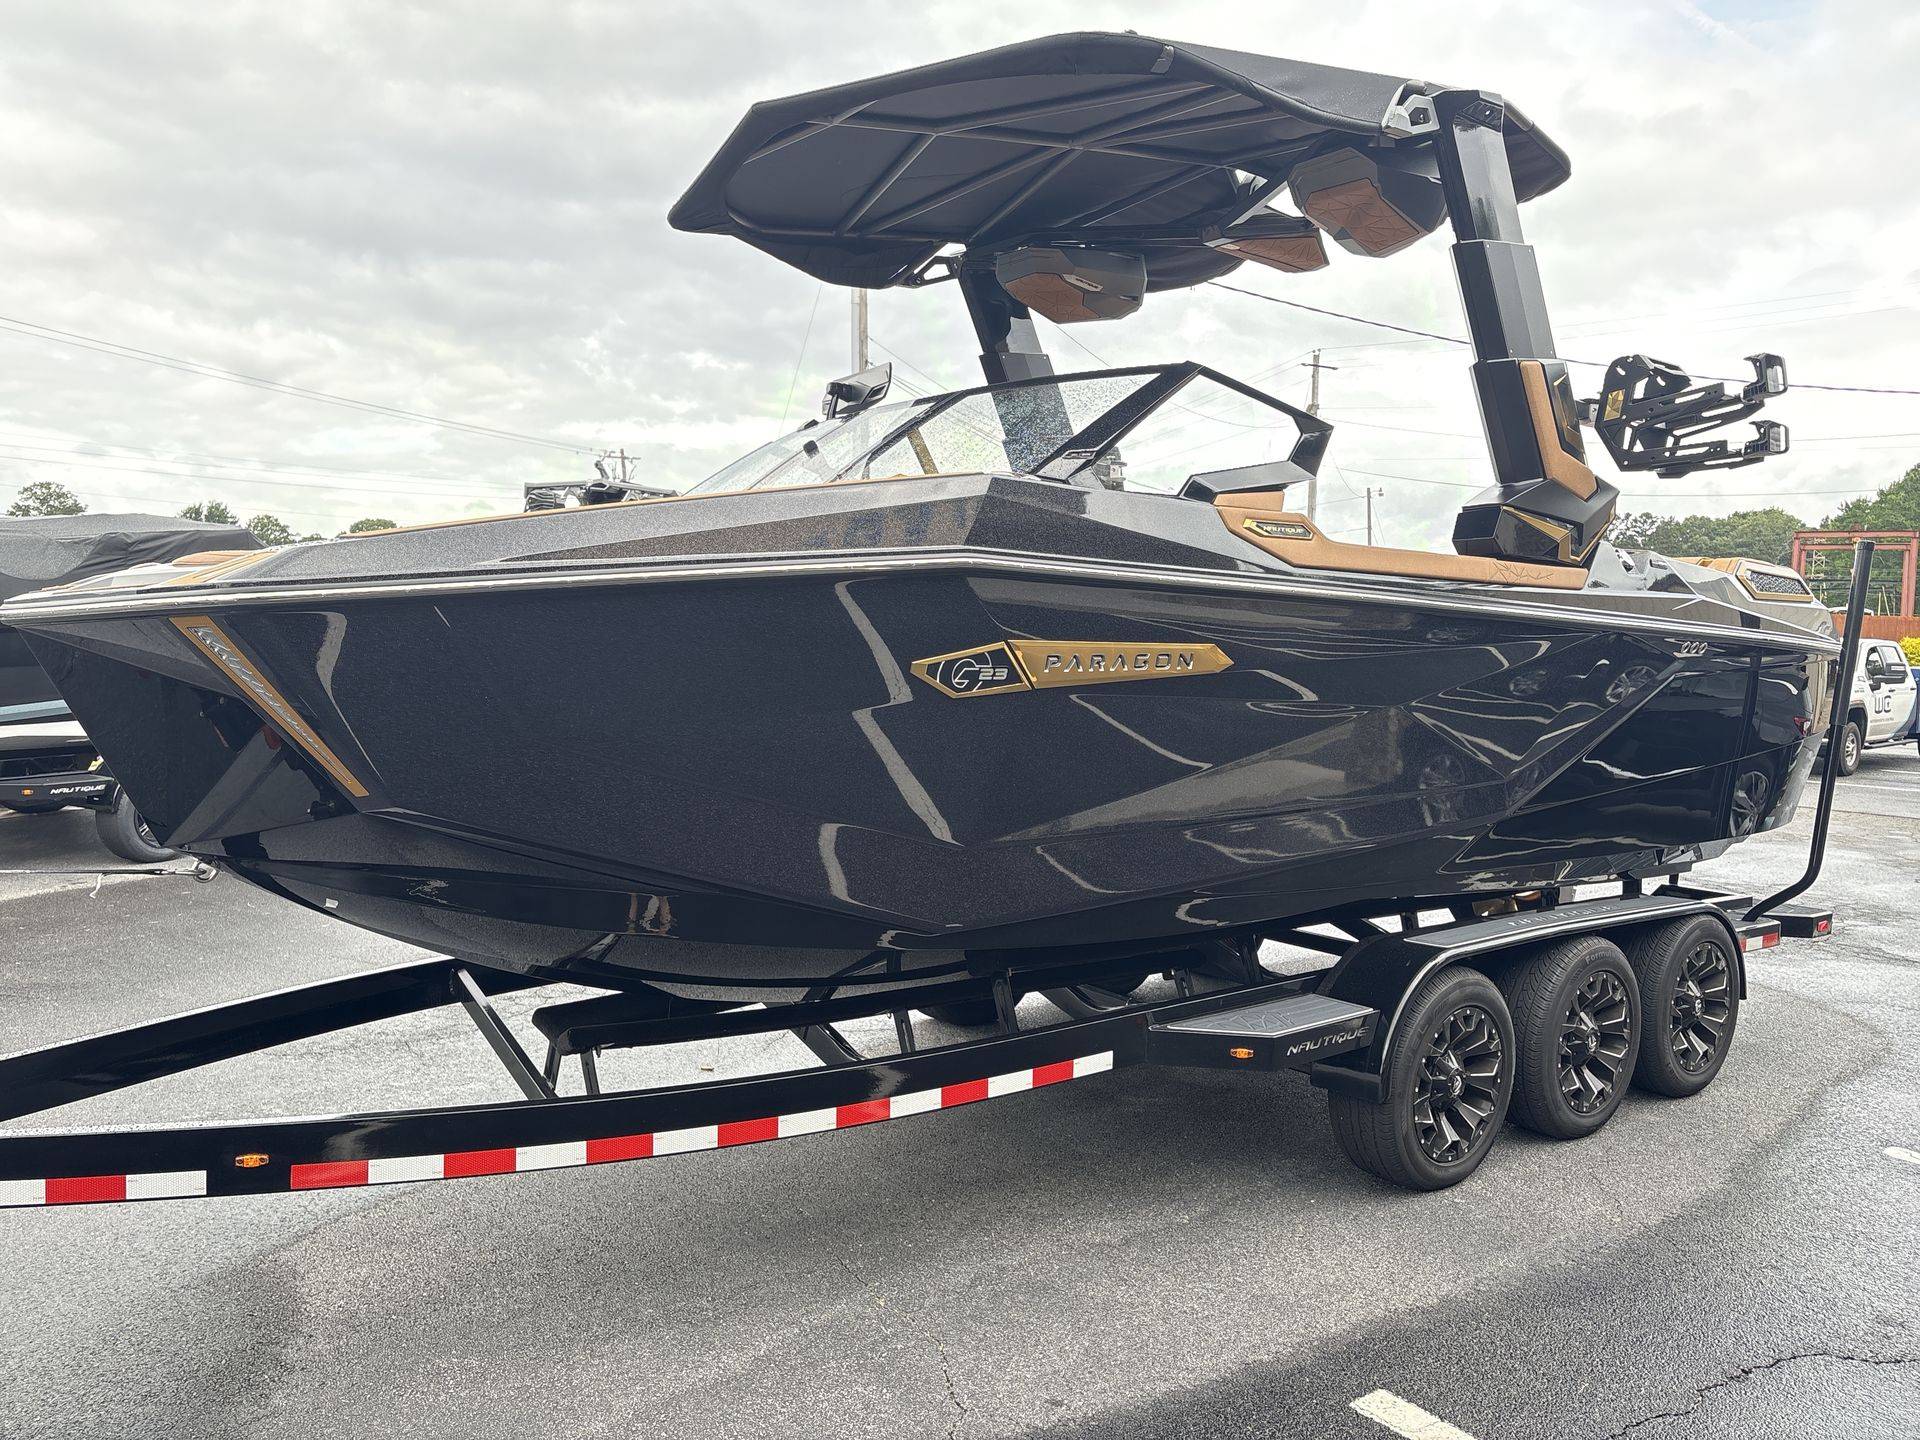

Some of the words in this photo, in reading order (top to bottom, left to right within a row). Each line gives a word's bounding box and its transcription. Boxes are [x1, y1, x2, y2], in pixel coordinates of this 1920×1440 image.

[1043, 652, 1195, 673] PARAGON
[50, 784, 107, 795] NAUTIQUE
[1286, 1026, 1370, 1057] NAUTIQUE
